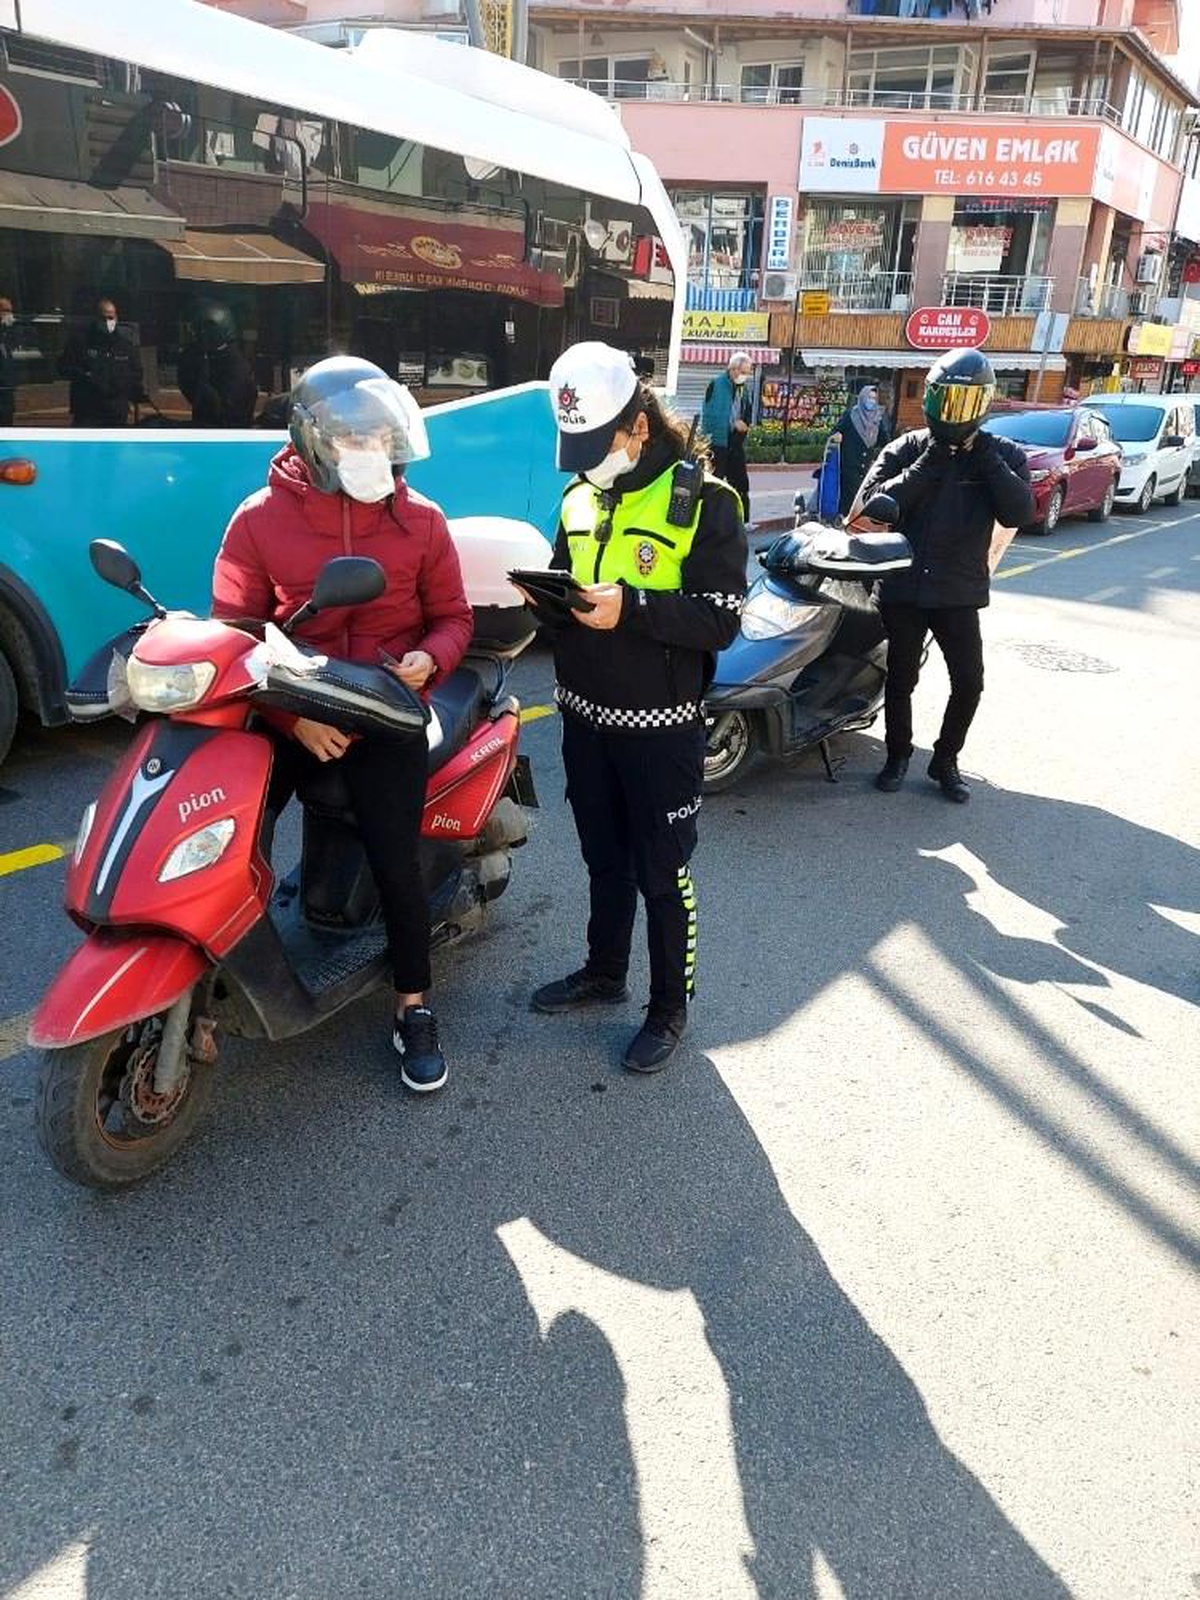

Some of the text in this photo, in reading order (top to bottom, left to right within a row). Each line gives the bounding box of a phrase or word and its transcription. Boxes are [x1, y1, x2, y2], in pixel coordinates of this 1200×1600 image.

[904, 131, 1079, 163] GÜVEN EMLAK
[829, 157, 877, 169] DenizBank
[934, 169, 1042, 188] TEL: 616 43 45
[177, 786, 227, 823] pion
[431, 812, 462, 833] pion
